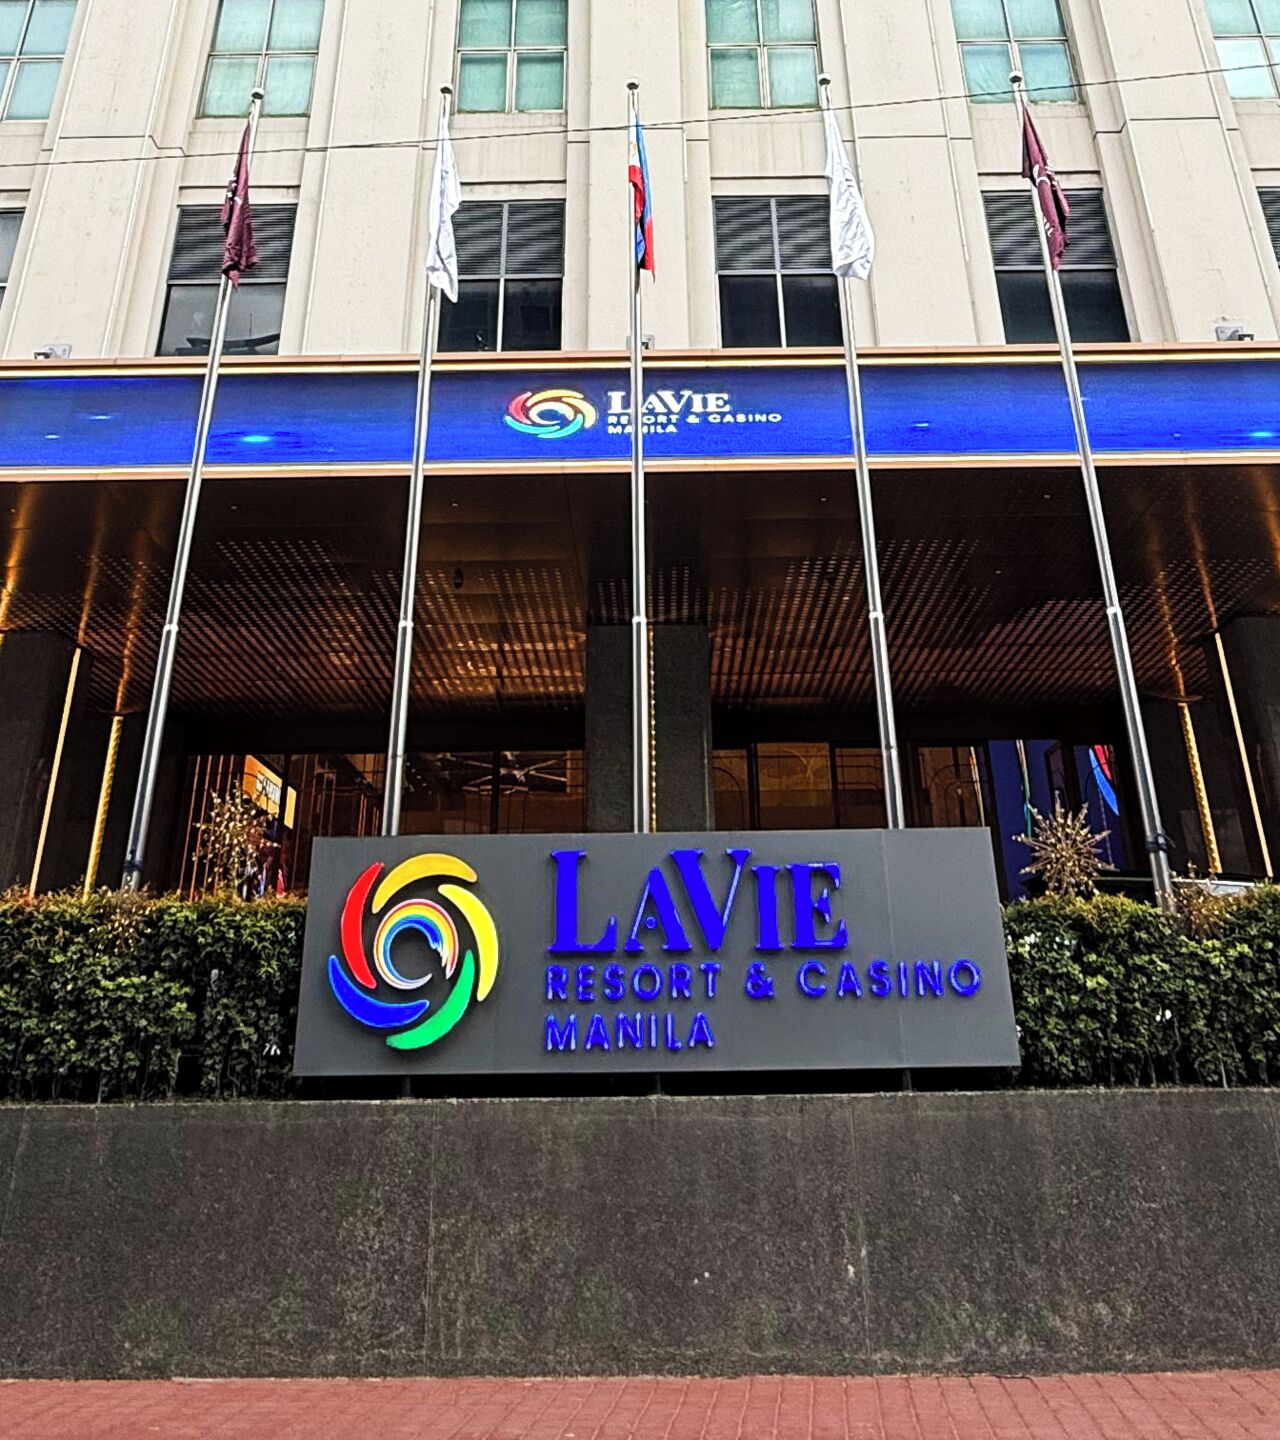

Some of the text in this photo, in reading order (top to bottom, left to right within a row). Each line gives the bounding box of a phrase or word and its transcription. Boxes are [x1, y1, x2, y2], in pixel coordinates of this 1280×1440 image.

[607, 413, 783, 425] REORT & CASINO
[545, 958, 982, 1002] RESORT & CASINO
[545, 1011, 716, 1052] MANILA
